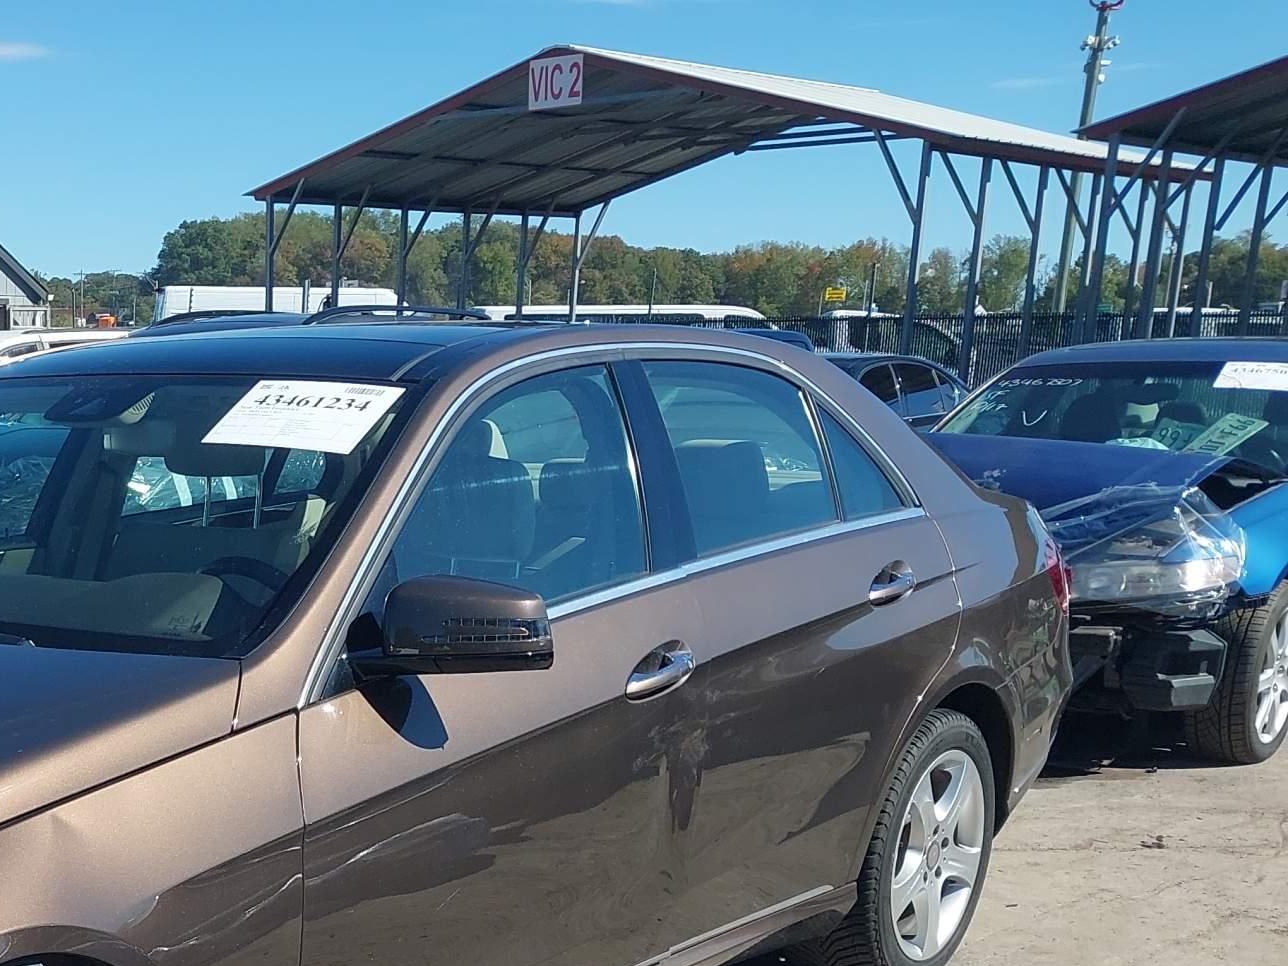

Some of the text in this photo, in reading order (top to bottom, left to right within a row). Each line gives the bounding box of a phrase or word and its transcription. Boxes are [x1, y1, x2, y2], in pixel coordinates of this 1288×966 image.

[531, 62, 581, 102] VIC 2
[254, 395, 372, 411] 43461234
